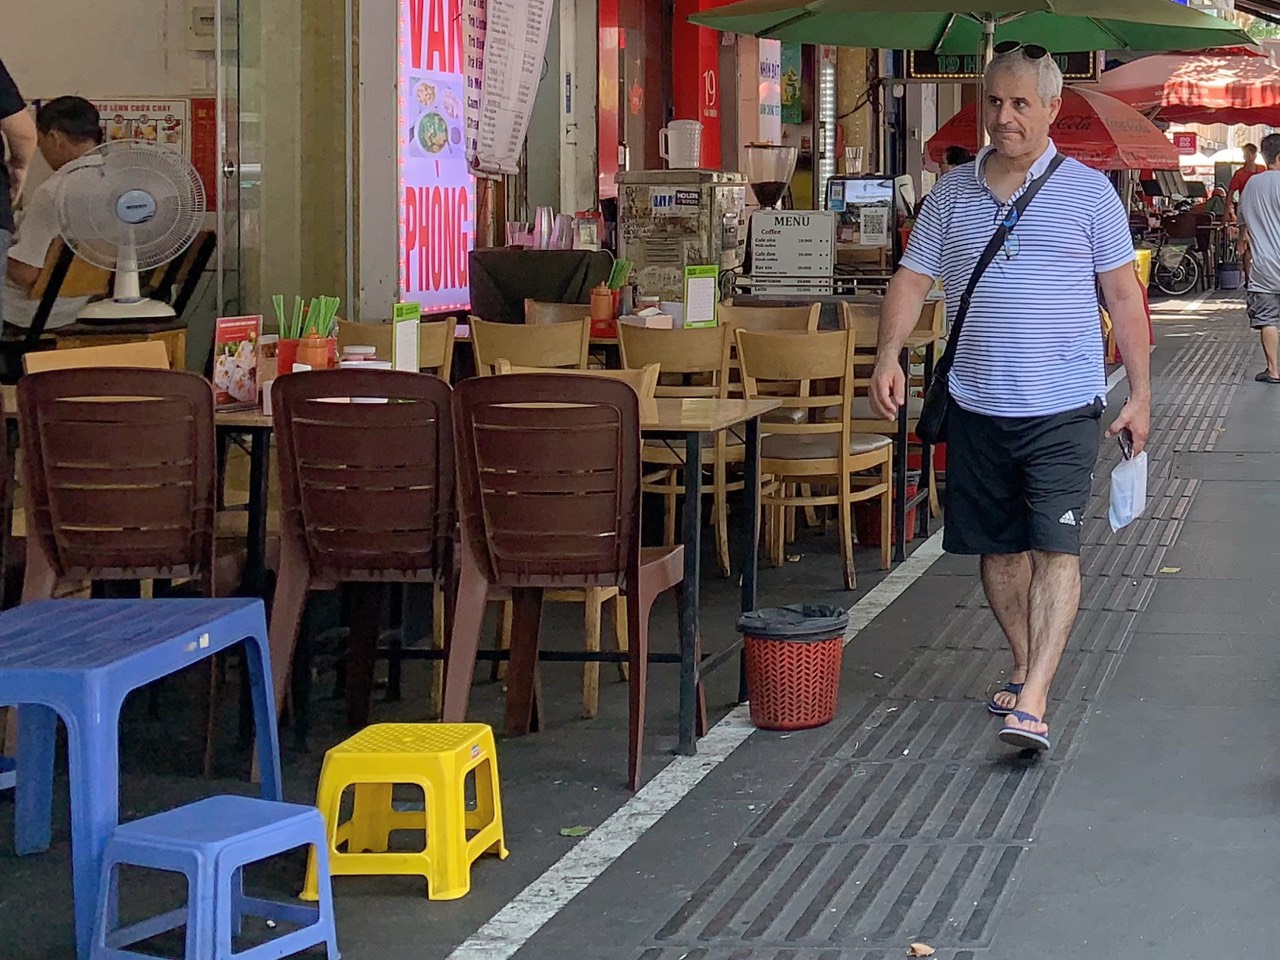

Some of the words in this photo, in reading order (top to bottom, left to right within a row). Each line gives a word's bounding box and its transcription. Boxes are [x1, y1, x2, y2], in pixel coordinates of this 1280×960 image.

[937, 55, 960, 73] 19
[703, 69, 716, 107] 19
[405, 159, 468, 293] PHÒNG
[774, 216, 810, 227] MENU
